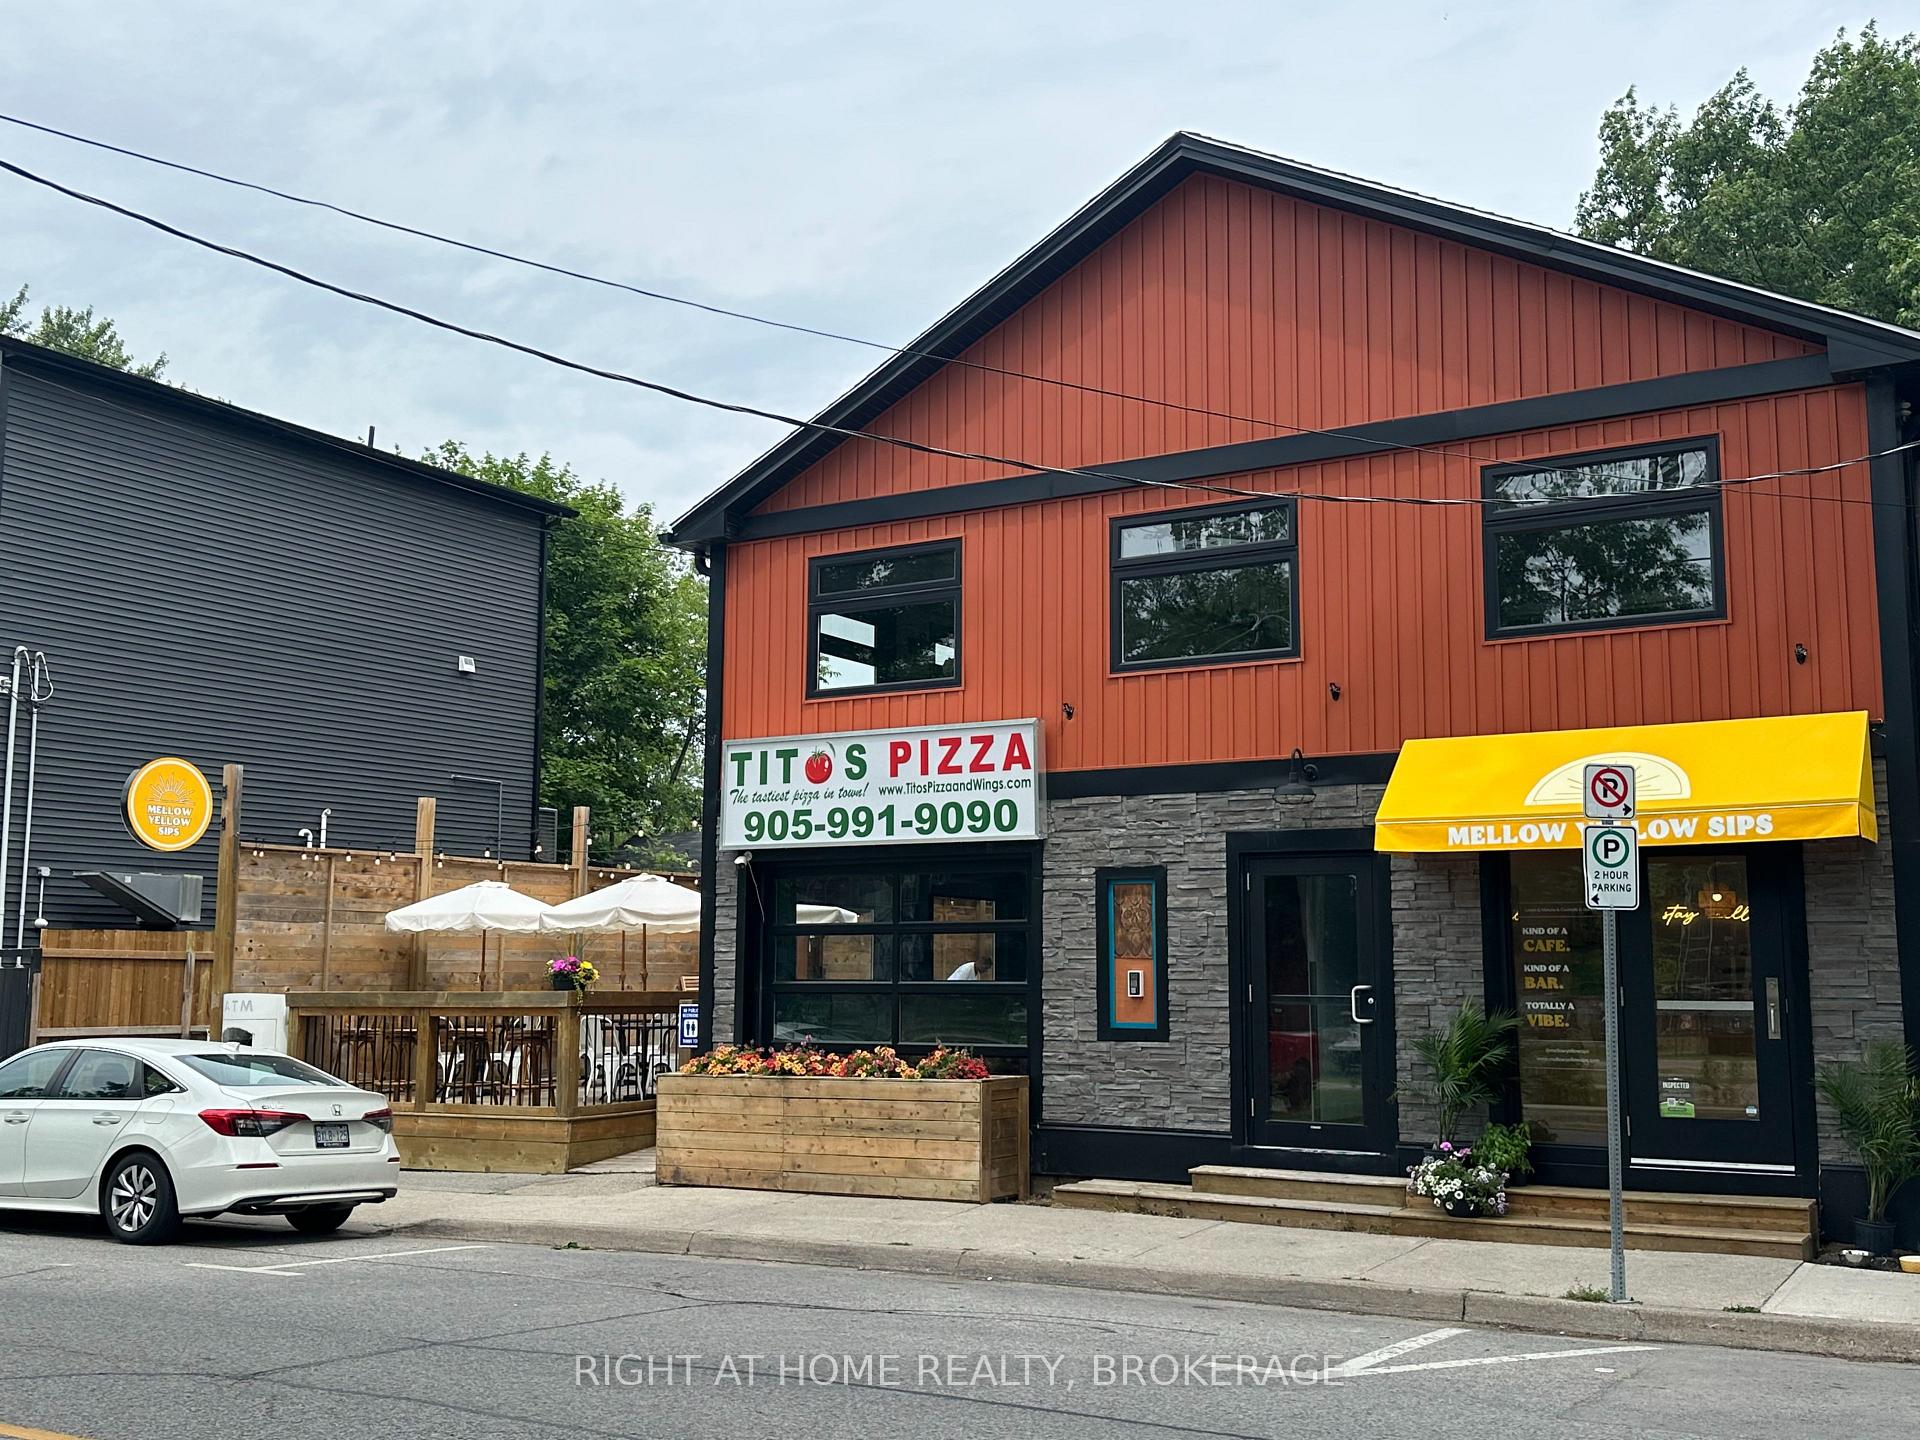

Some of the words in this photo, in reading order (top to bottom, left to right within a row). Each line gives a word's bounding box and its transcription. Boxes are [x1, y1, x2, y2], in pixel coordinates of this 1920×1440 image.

[889, 732, 1032, 777] PIZZA
[878, 777, 1031, 796] www.TitosPizzaandWings.com
[730, 789, 748, 805] The
[752, 789, 790, 804] tastiest
[792, 788, 820, 806] pizza
[824, 787, 834, 799] in
[838, 782, 869, 798] town!
[147, 805, 192, 816] MELLOW
[148, 815, 191, 826] YELLOW
[744, 798, 1018, 842] 905-991-9090
[158, 827, 180, 836] SIPS
[1447, 822, 1567, 846] MELLOW
[1707, 813, 1774, 837] SIPS
[1594, 871, 1601, 880] 2
[1603, 870, 1629, 880] HOUR
[1592, 883, 1632, 893] PARKING
[1662, 904, 1699, 926] stay
[1522, 927, 1545, 935] KIND
[1546, 927, 1560, 935] OF
[1561, 927, 1568, 935] A
[1523, 939, 1571, 952] CAFE.
[1523, 964, 1547, 972] KIND
[1548, 964, 1561, 972] OF
[1562, 964, 1570, 972] A
[1524, 976, 1564, 989] BAR.
[224, 1000, 253, 1012] ATM
[1526, 1002, 1566, 1010] TOTALLY
[1567, 1002, 1575, 1010] A
[1526, 1014, 1570, 1027] VIBE.
